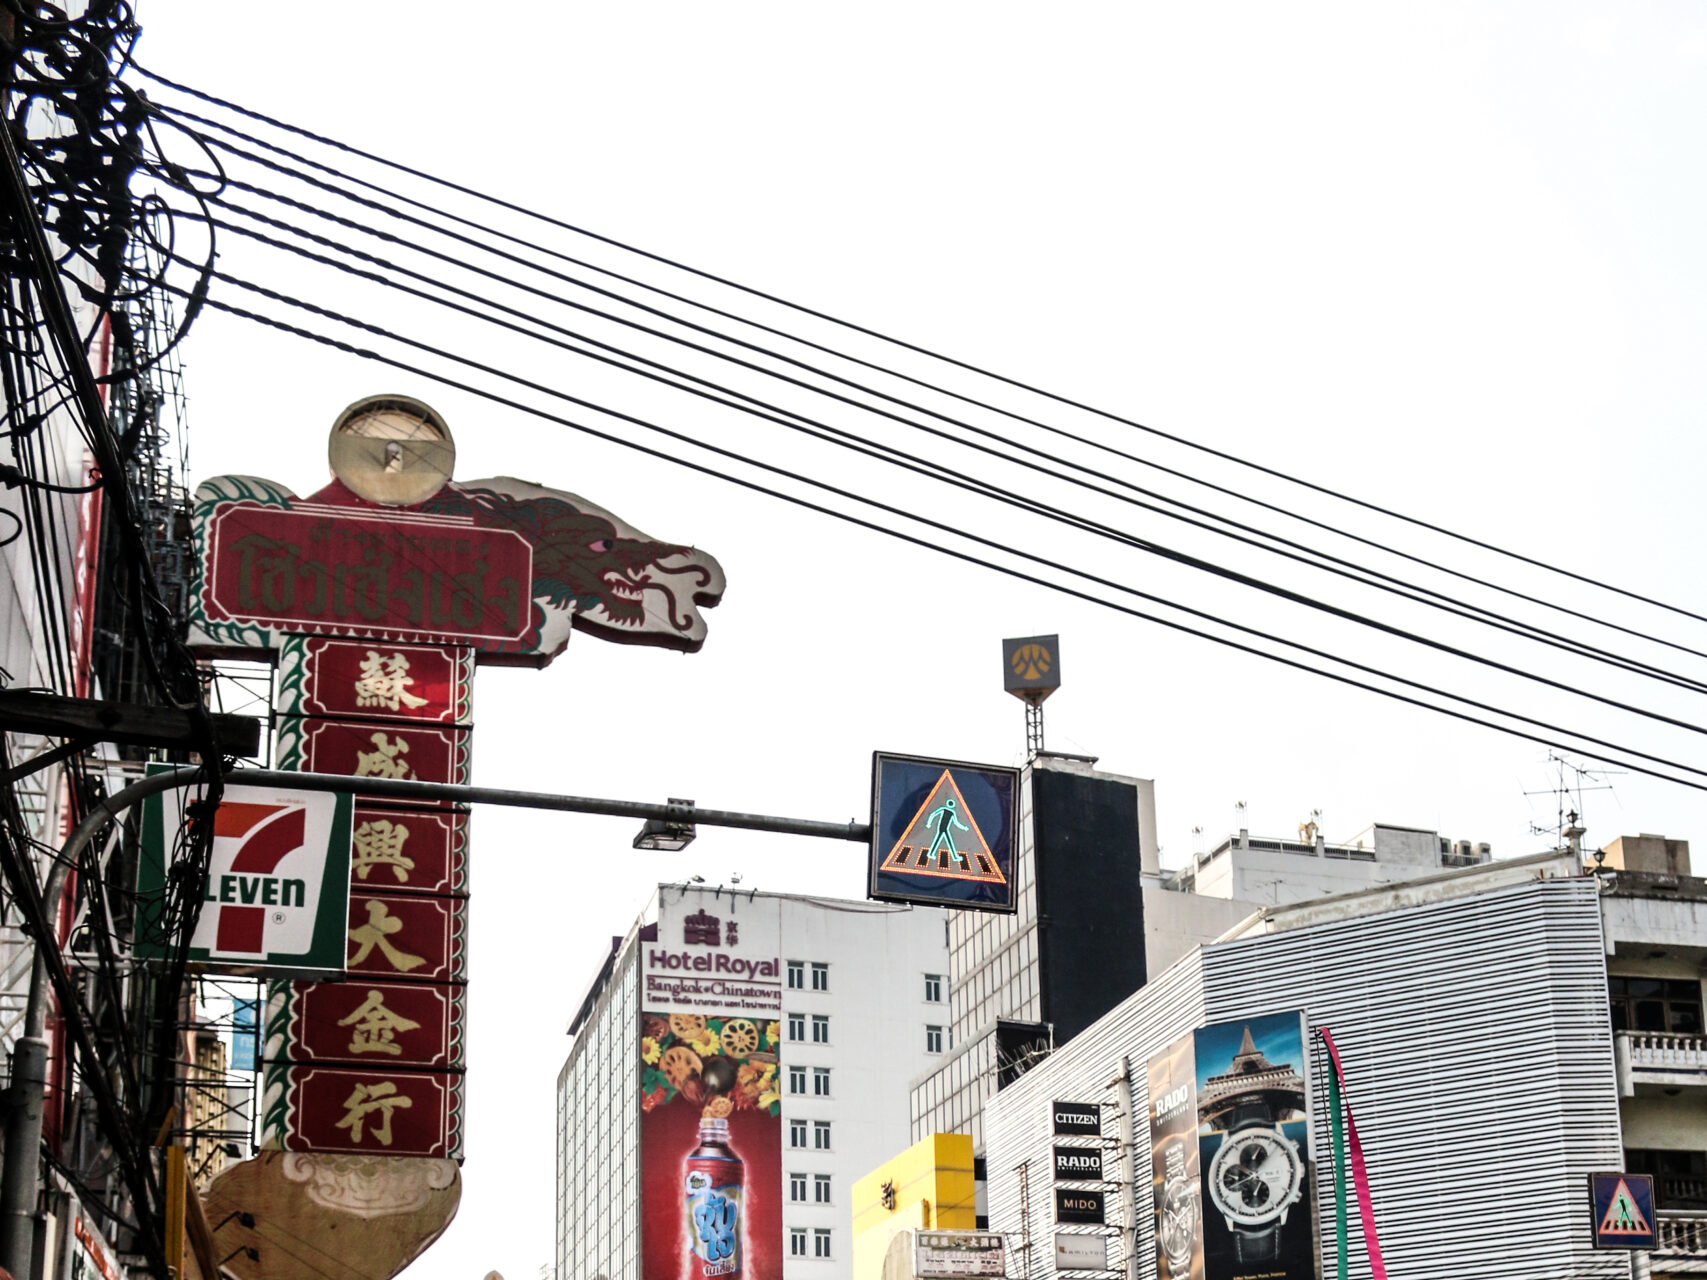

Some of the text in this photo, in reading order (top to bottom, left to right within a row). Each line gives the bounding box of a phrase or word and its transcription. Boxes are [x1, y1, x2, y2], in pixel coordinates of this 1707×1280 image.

[650, 950, 779, 979] Hotel Royal
[1156, 1085, 1188, 1118] RADO
[1055, 1113, 1098, 1125] CITIZEN
[1057, 1156, 1100, 1167] RADO
[1064, 1199, 1097, 1209] MIDO
